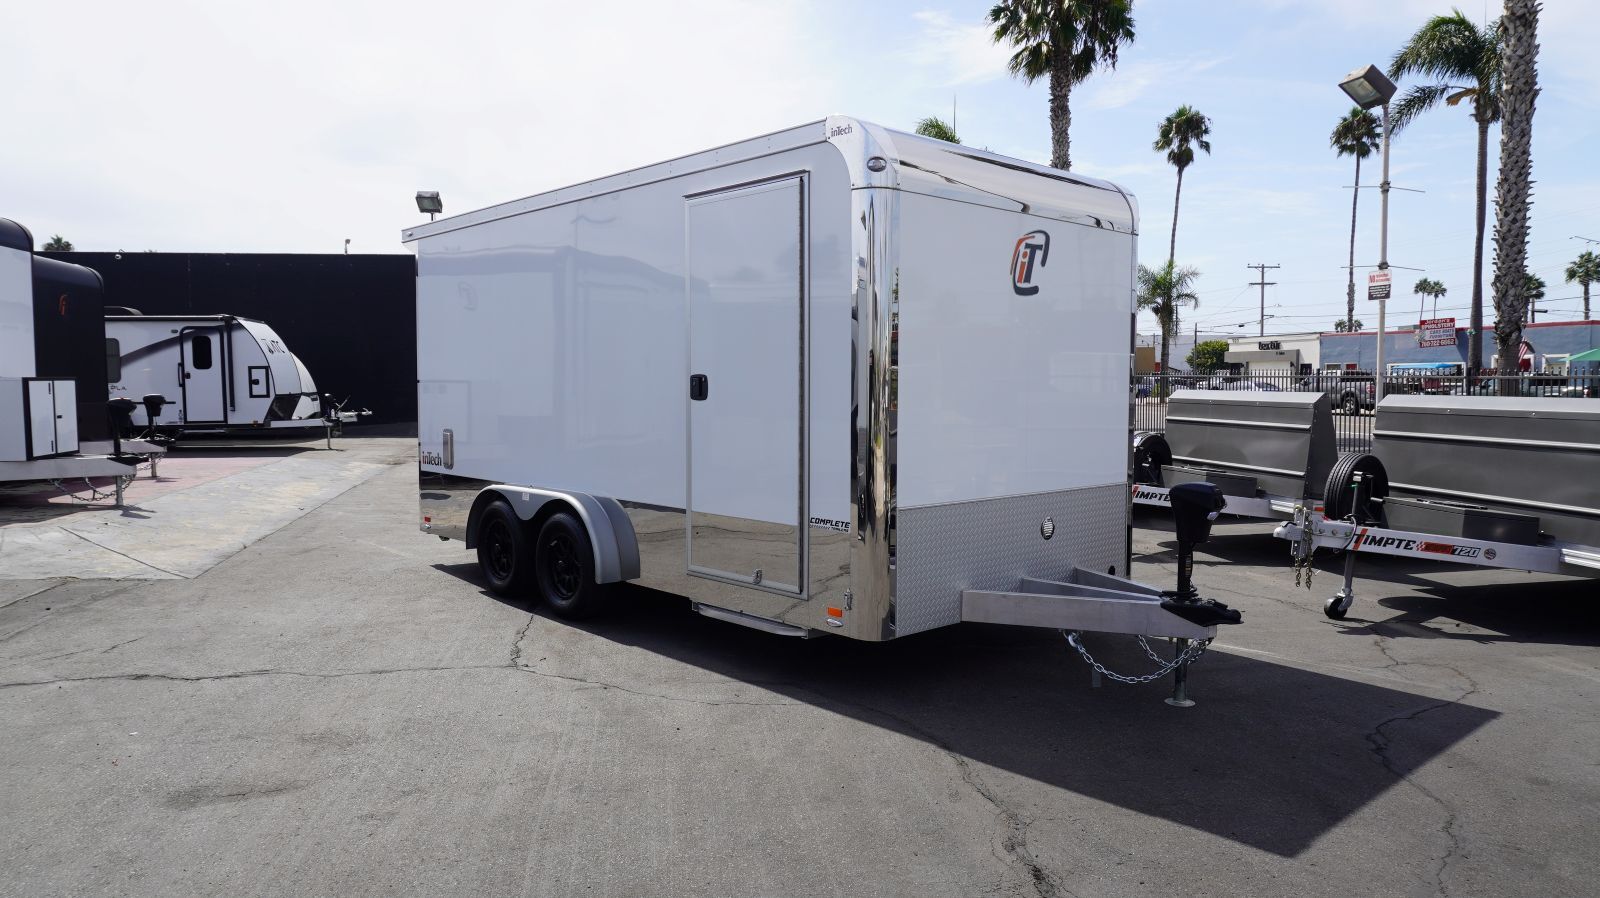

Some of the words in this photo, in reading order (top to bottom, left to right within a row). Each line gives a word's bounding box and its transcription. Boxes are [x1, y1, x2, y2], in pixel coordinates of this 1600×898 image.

[831, 124, 853, 137] inTech
[422, 451, 442, 466] inTech
[810, 517, 851, 529] COMPLETE
[1353, 531, 1416, 551] TIMPTE
[1453, 545, 1480, 558] 720
